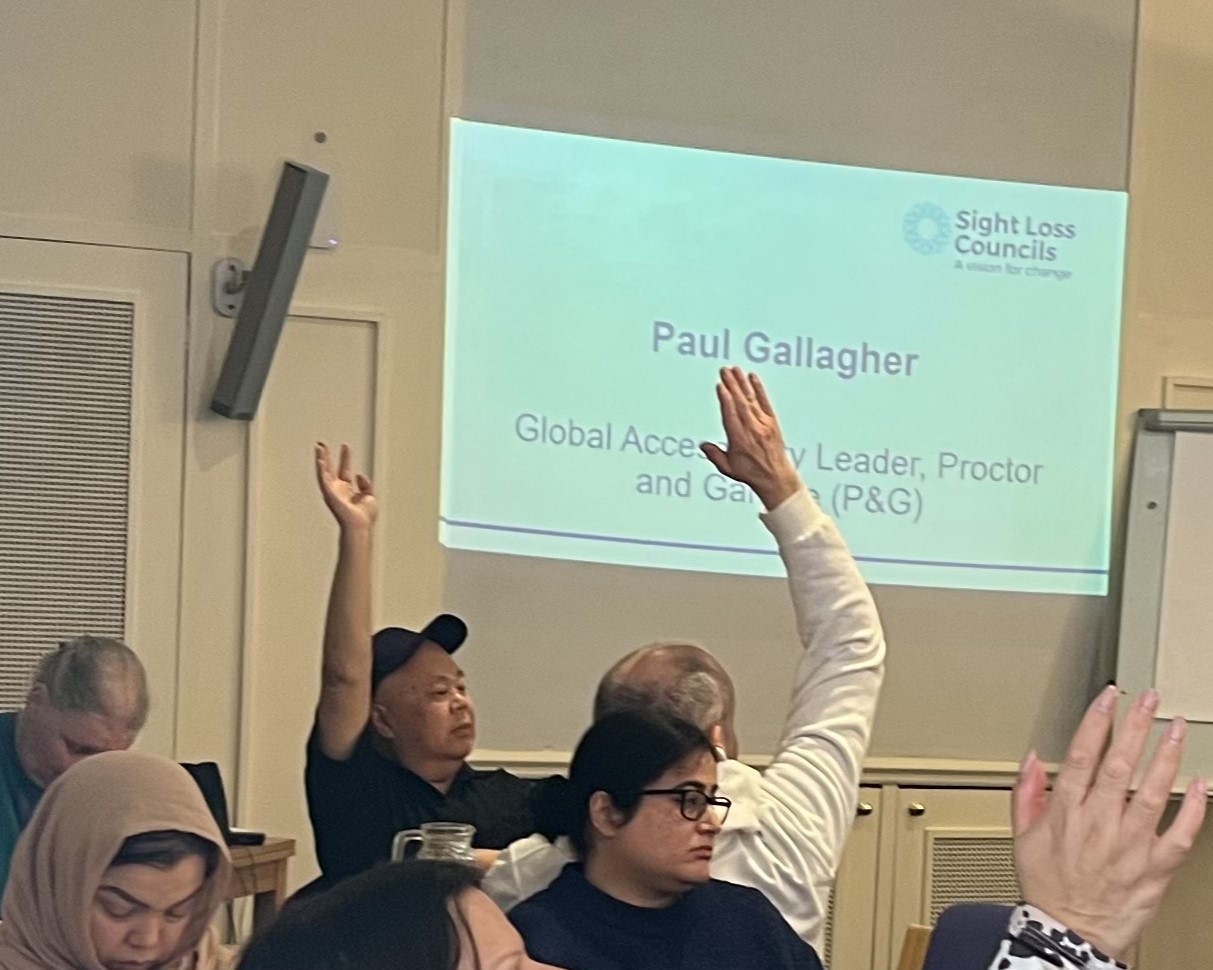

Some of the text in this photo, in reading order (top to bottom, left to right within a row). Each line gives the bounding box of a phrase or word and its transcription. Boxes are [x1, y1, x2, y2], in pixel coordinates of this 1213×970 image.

[954, 235, 1058, 261] Councils
[955, 209, 1076, 239] Sight Loss
[652, 320, 920, 380] Paul Gallagher
[515, 413, 611, 450] Global
[817, 443, 926, 481] Leader,
[938, 451, 1045, 484] Proctor
[636, 471, 691, 498] and
[831, 483, 923, 523] (P&G)
